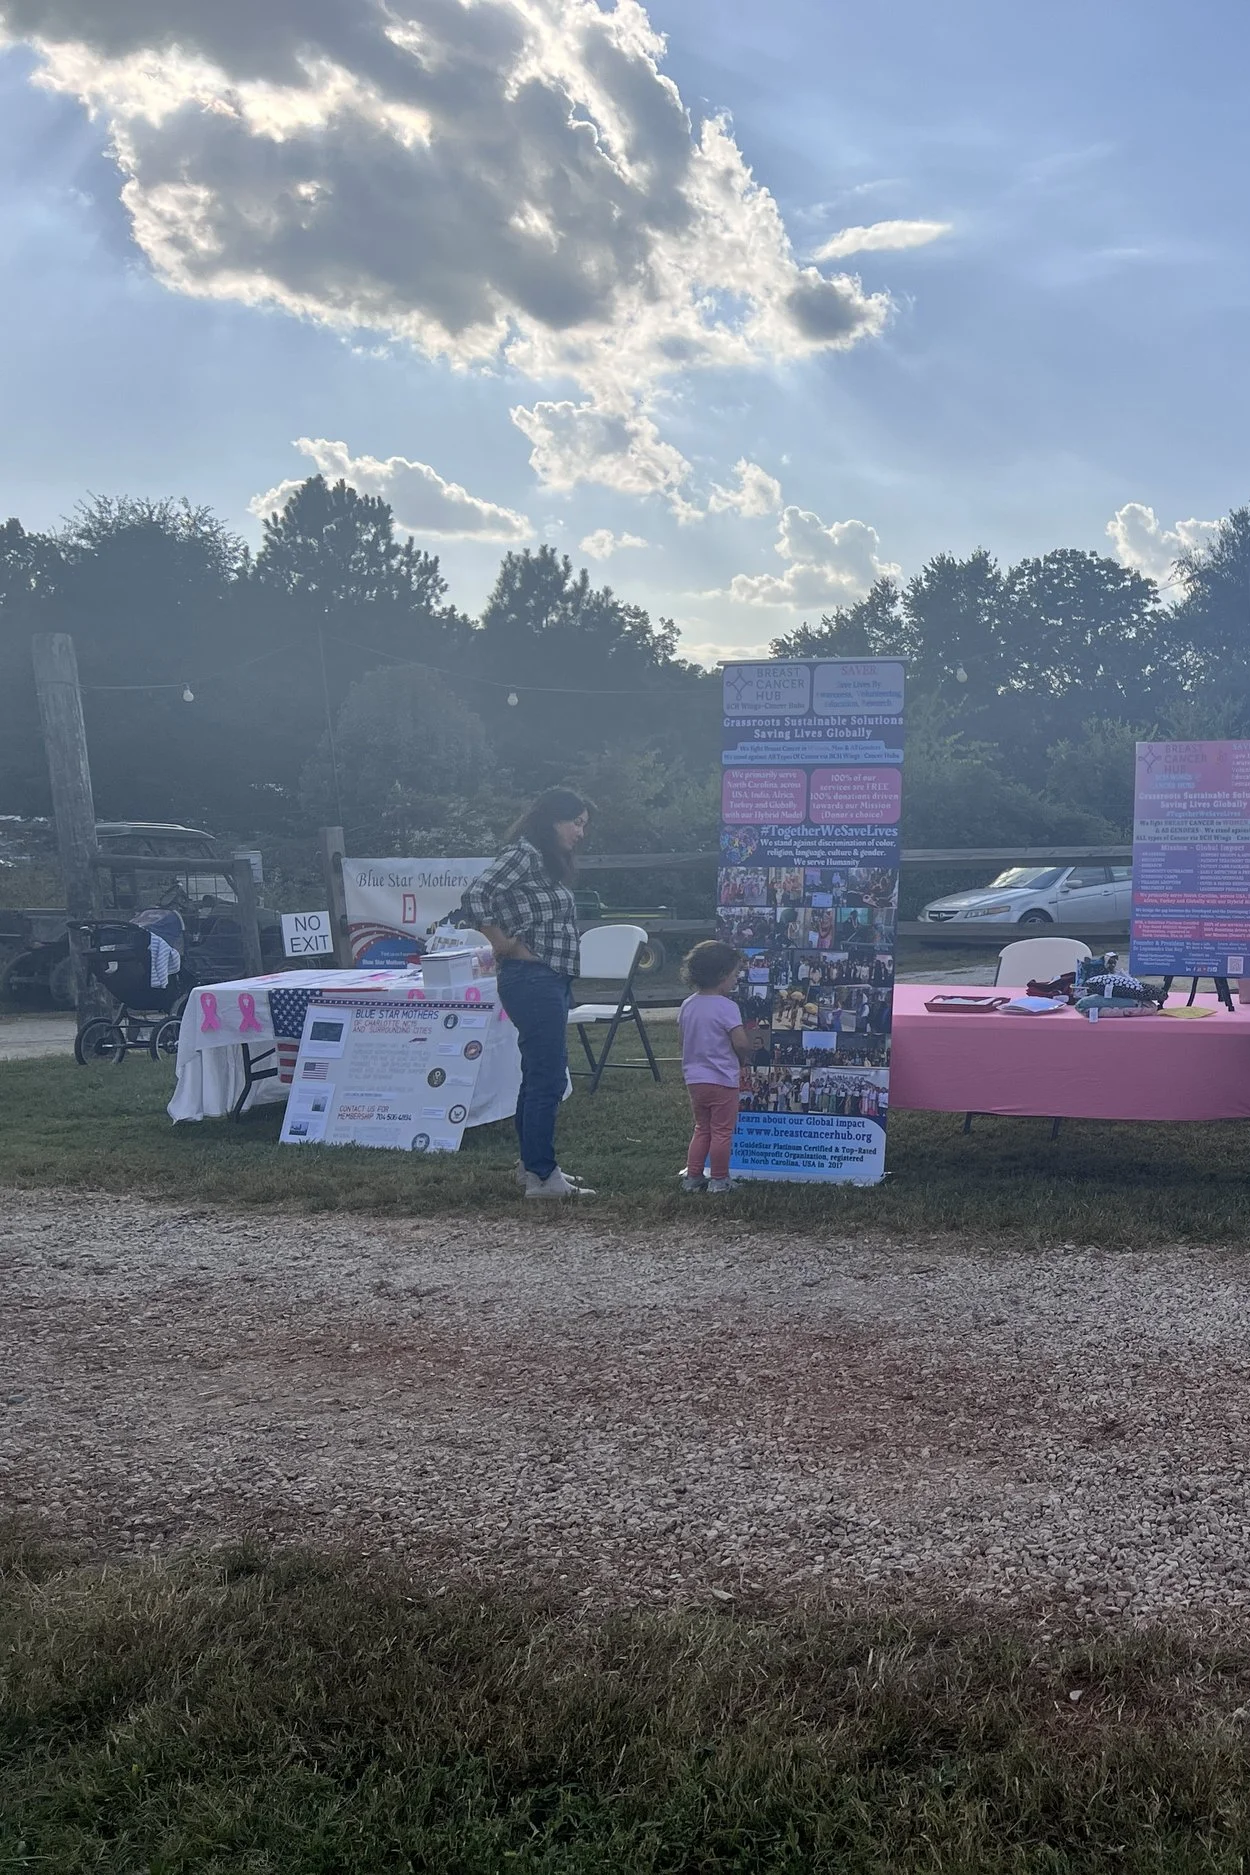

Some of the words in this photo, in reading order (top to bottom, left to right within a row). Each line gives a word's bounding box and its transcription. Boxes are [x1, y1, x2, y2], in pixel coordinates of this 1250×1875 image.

[757, 668, 800, 677] BREAST
[841, 666, 877, 676] SAVER
[756, 679, 805, 689] CANCER
[756, 691, 781, 700] HUB
[724, 718, 780, 727] Grassroots
[784, 717, 847, 726] Sustainable
[851, 716, 903, 725] Solutions
[754, 729, 790, 740] Saving
[795, 729, 822, 738] Lives
[827, 728, 872, 739] Globally
[747, 772, 778, 780] primarily
[832, 774, 851, 782] 100%
[769, 801, 797, 809] Globally
[1214, 801, 1247, 809] Globally
[755, 811, 779, 820] Hybrid
[760, 825, 898, 839] #TogetherWeSaveLives
[760, 839, 772, 847] We
[793, 839, 816, 848] against
[818, 839, 866, 847] discrimination
[868, 839, 875, 847] of
[876, 839, 896, 848] color,
[1221, 844, 1244, 852] Impact
[794, 858, 805, 866] We
[827, 858, 860, 868] Humanity
[357, 870, 385, 888] Blue
[388, 872, 413, 887] Star
[418, 870, 468, 888] Mothers
[294, 915, 321, 931] NO
[290, 935, 328, 953] EXIT
[356, 1009, 376, 1018] BLUE
[379, 1010, 400, 1019] STAR
[401, 1011, 439, 1019] MOTHERS
[739, 1114, 760, 1123] learn
[763, 1115, 786, 1125] about
[789, 1117, 804, 1125] our
[806, 1117, 833, 1126] Global
[836, 1118, 865, 1130] impact
[747, 1127, 872, 1143] www.breastcancerhub.org
[740, 1142, 771, 1150] GuideStar
[773, 1142, 802, 1150] Platinum
[804, 1144, 833, 1152] Certified
[842, 1147, 876, 1155] Top-Rated
[751, 1157, 769, 1165] North
[829, 1161, 843, 1169] 2017
[831, 1154, 863, 1163] registered
